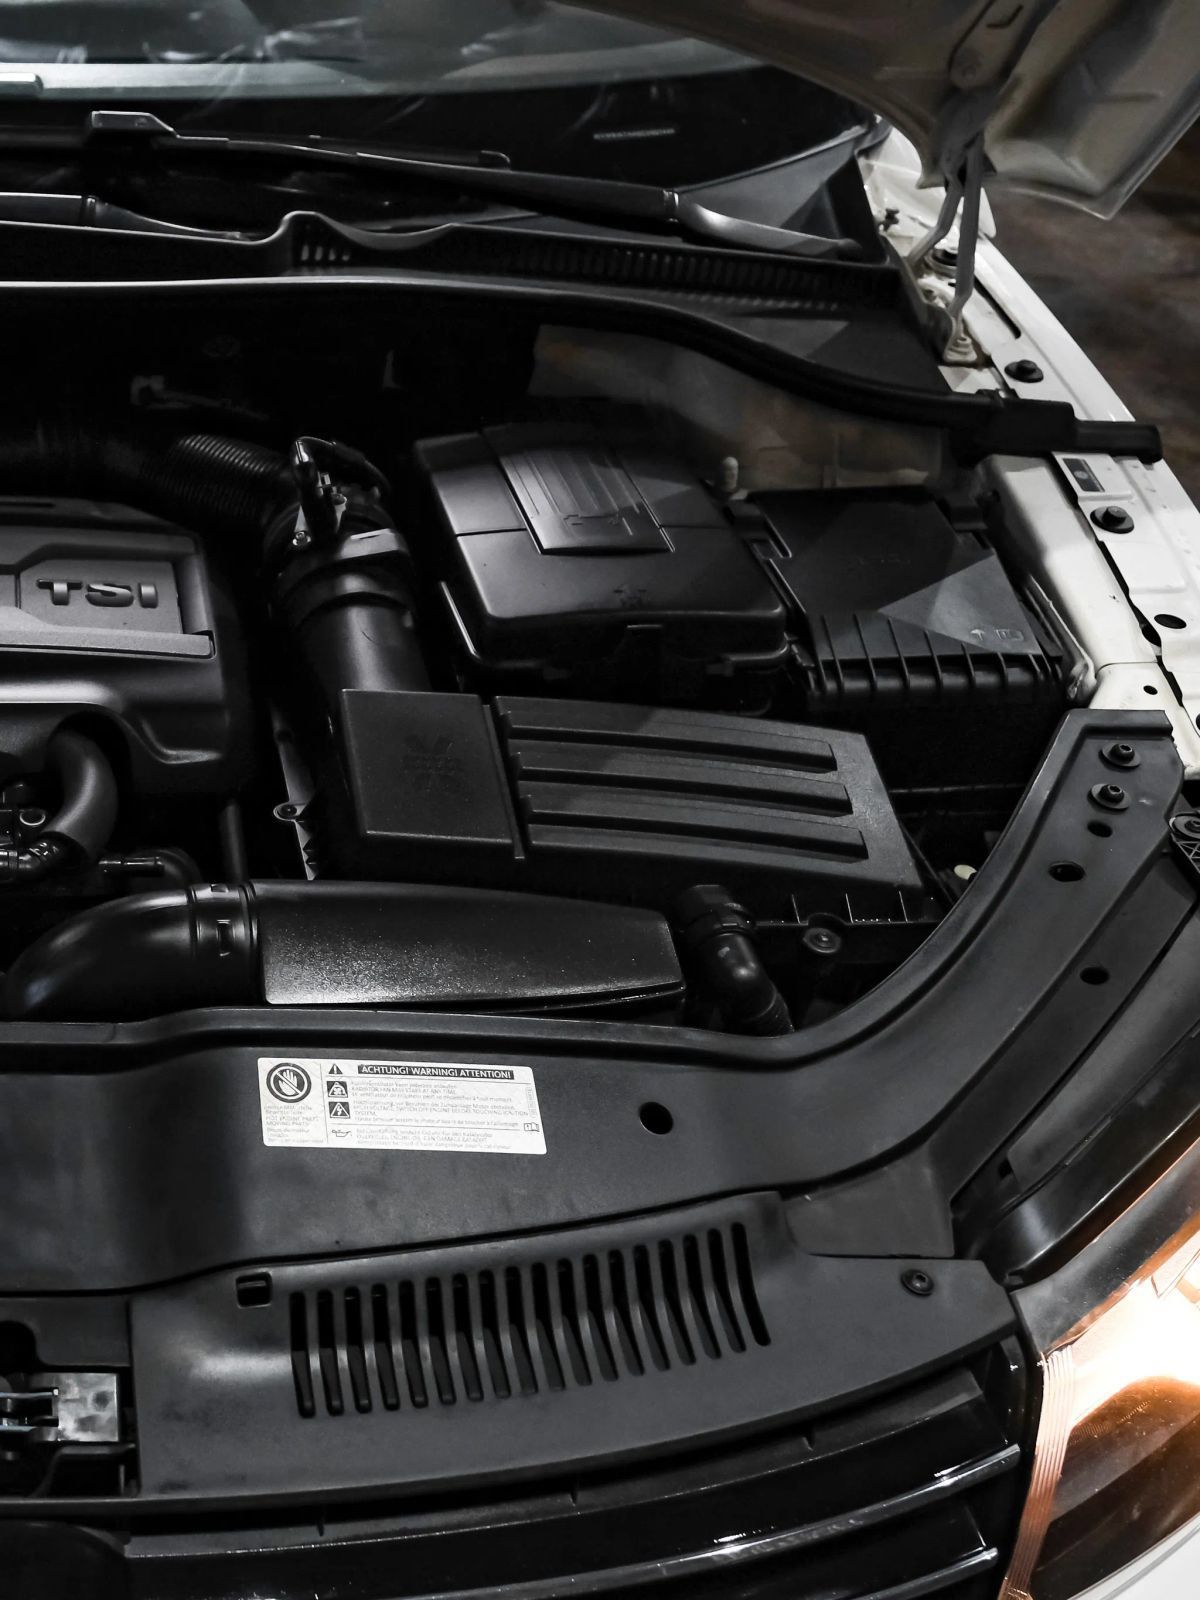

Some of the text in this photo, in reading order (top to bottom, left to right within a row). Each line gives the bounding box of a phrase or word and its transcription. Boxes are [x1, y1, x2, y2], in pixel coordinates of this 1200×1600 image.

[36, 578, 158, 608] TSI
[362, 1066, 511, 1079] ACHTUNG! WARNING! ATTENTION!
